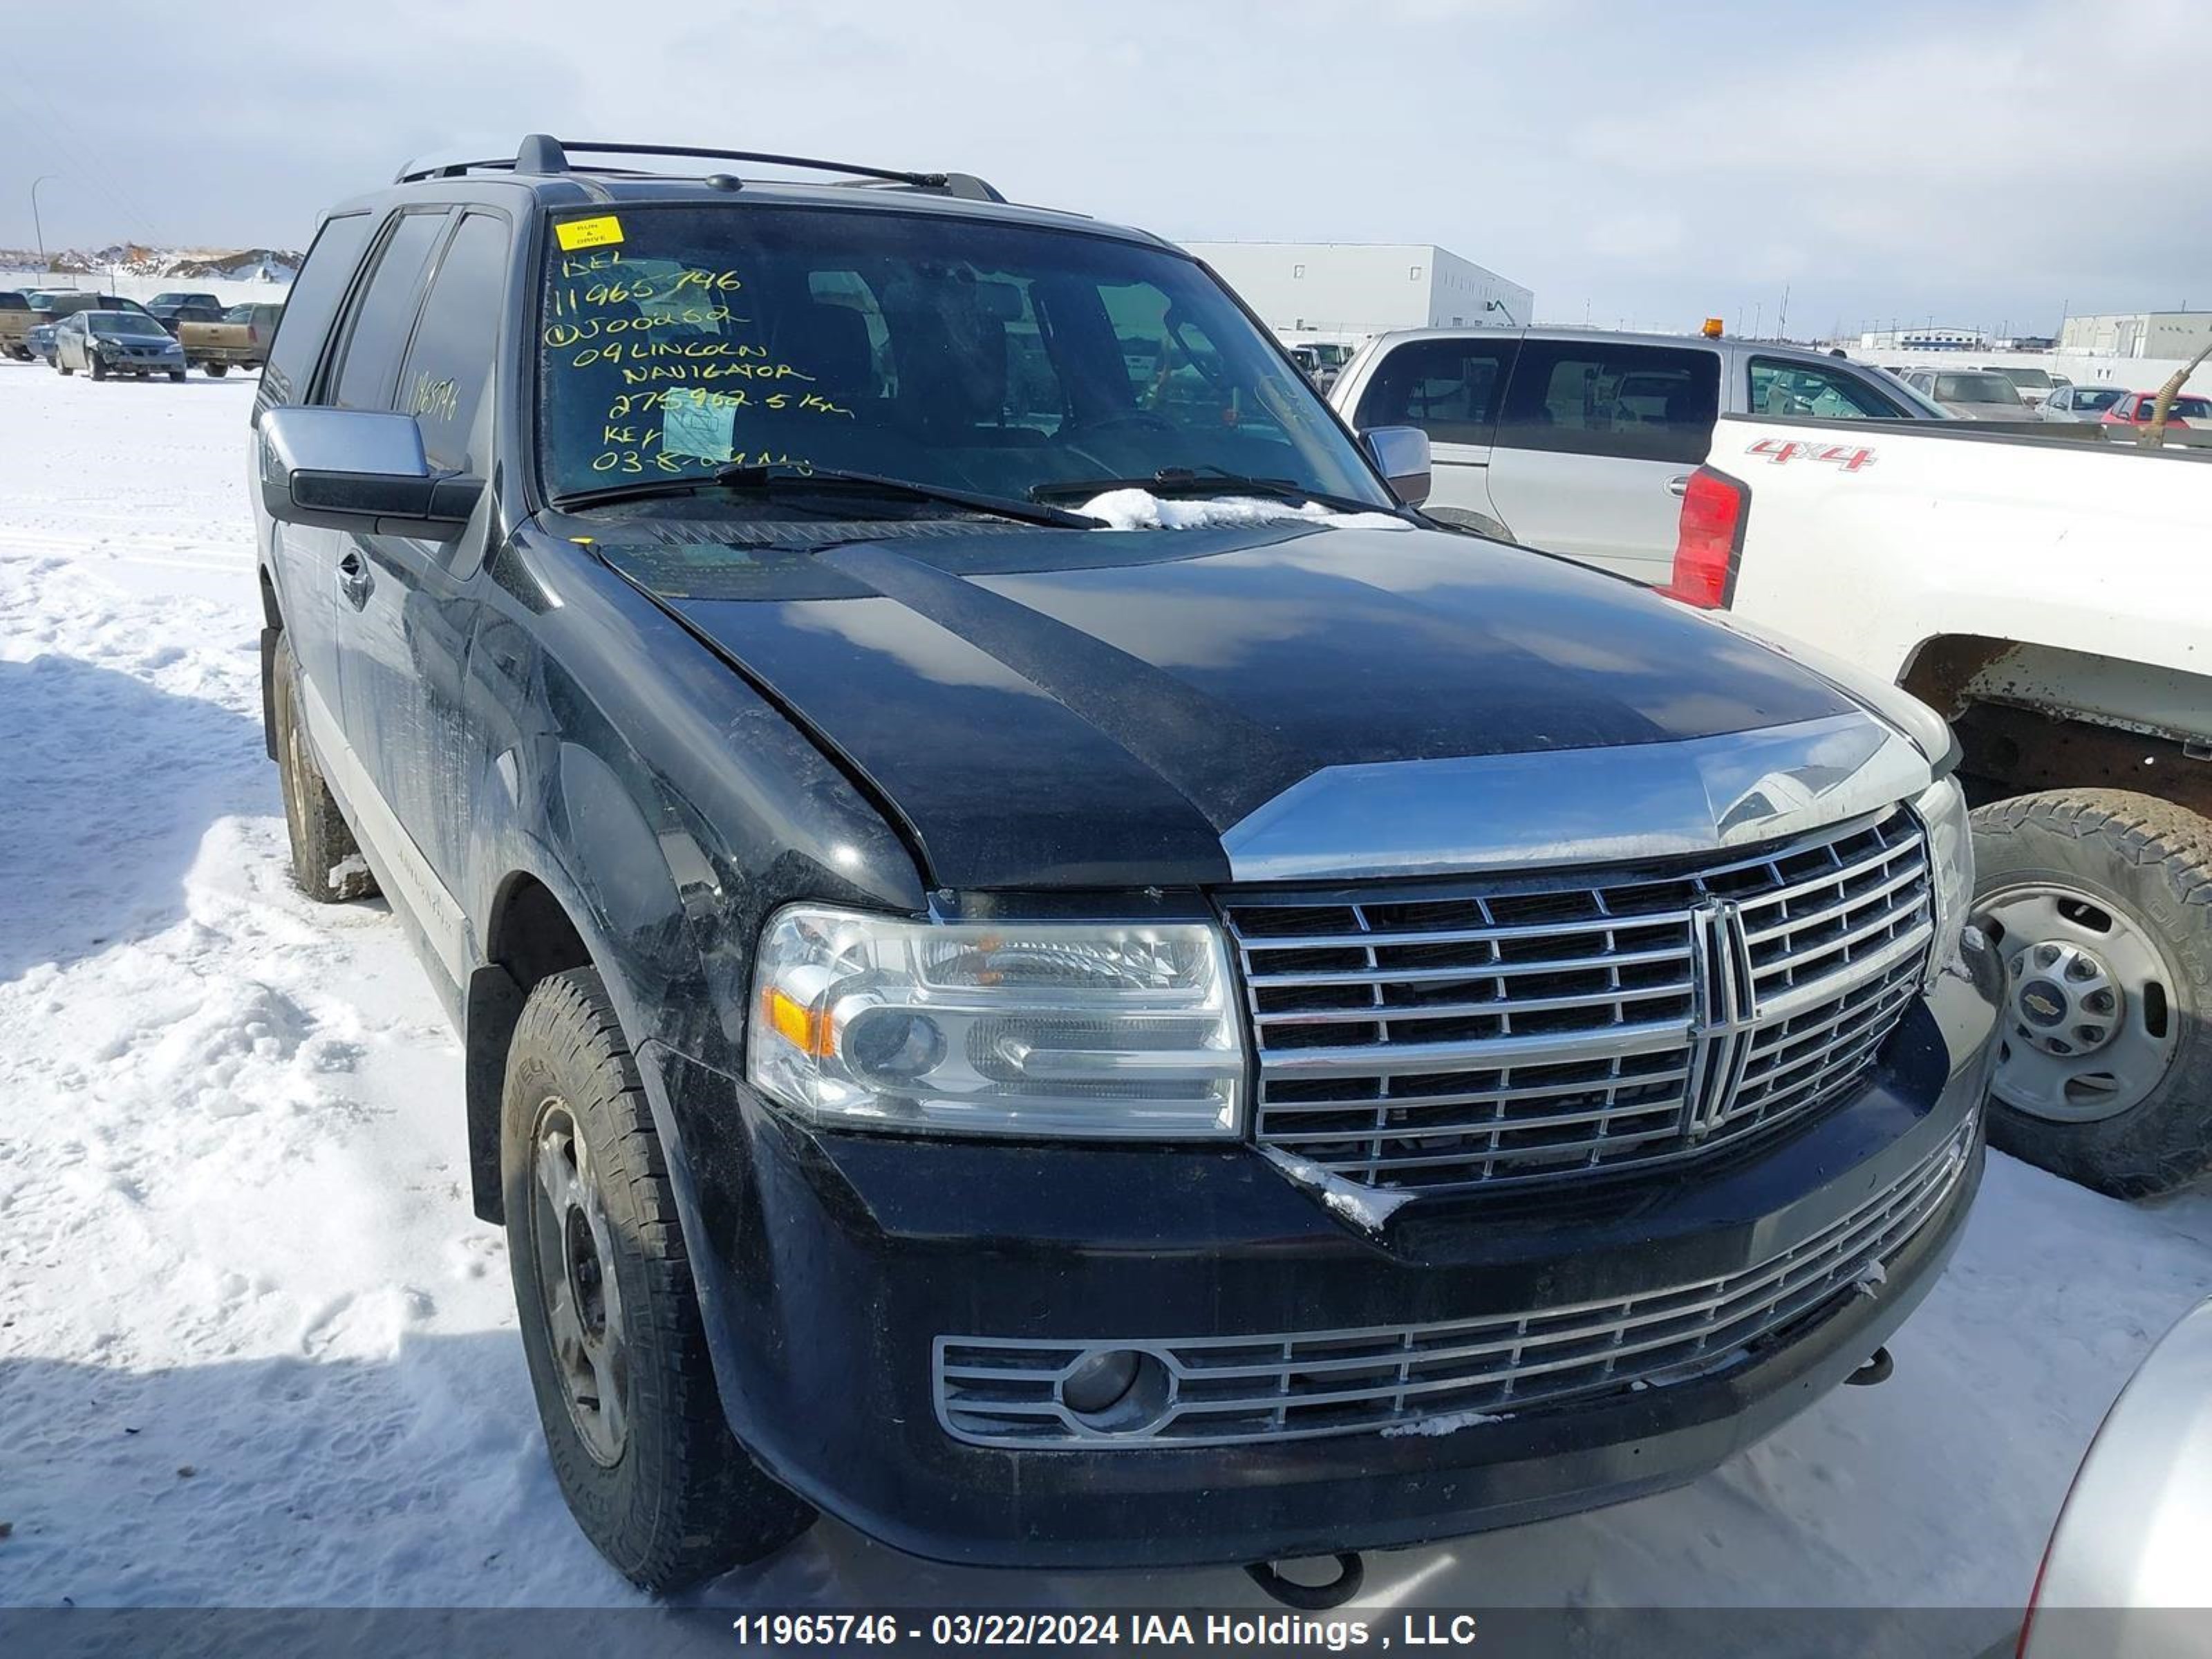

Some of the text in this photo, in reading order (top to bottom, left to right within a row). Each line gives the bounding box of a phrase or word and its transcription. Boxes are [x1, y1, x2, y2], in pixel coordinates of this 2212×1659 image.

[573, 342, 767, 367] 09 LINCOLN
[622, 364, 816, 384] NAVIGATOR
